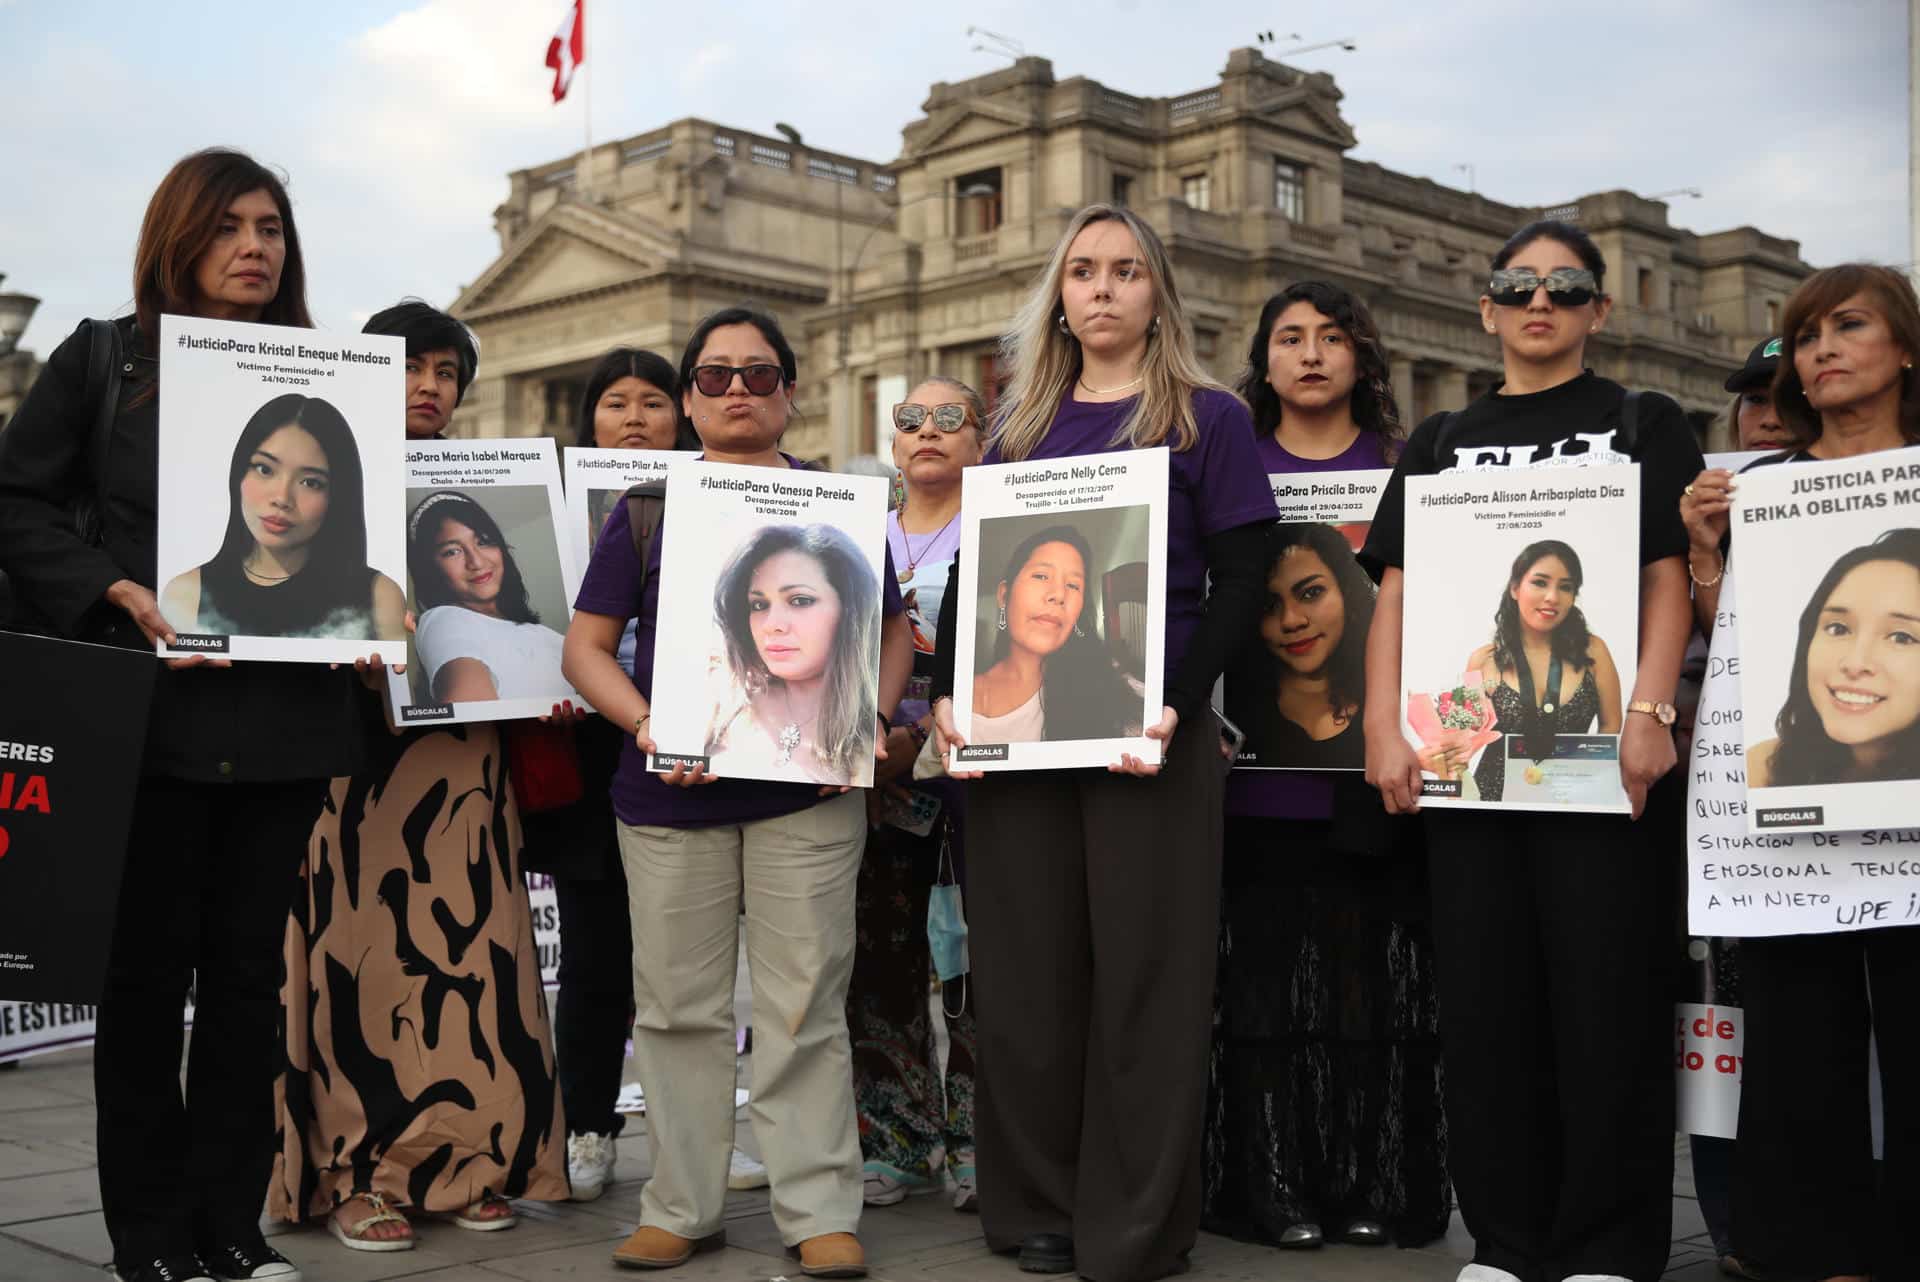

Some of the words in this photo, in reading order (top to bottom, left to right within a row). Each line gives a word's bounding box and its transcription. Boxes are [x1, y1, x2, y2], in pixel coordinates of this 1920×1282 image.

[178, 335, 255, 354] #JusticiaPara
[259, 342, 295, 357] Kristal
[298, 346, 339, 362] Eneque
[341, 350, 391, 365] Mendoza
[274, 365, 325, 377] Feminicidio
[327, 369, 335, 377] el
[261, 375, 311, 386] 24/10/2025
[442, 451, 470, 463] Maria
[472, 451, 499, 462] Isabel
[501, 451, 541, 463] Marquez
[577, 459, 631, 470] #JusticiaPara
[632, 460, 651, 470] Pilar
[411, 469, 463, 477] Desaparecida
[464, 468, 471, 476] el
[1004, 470, 1068, 486] #JusticiaPara
[1071, 466, 1096, 480] Nelly
[1098, 464, 1127, 476] Cerna
[1792, 470, 1876, 495] JUSTICIA
[1882, 463, 1920, 483] PAR
[460, 477, 495, 486] Arequipa
[700, 476, 769, 493] #JusticiaPara
[772, 482, 813, 497] Vanessa
[815, 486, 855, 501] Pereida
[1015, 488, 1067, 500] Desaparecida
[1068, 487, 1076, 495] el
[1077, 484, 1114, 494] 17/12/2017
[1311, 483, 1346, 496] Priscila
[1348, 483, 1377, 495] Bravo
[1420, 492, 1489, 507] #JusticiaPara
[1491, 489, 1527, 503] Alisson
[1530, 487, 1597, 502] Arribasplata
[1600, 484, 1625, 498] Díaz
[745, 495, 800, 507] Desaparecida
[802, 500, 809, 508] el
[1025, 499, 1051, 509] Trujillo
[1059, 498, 1069, 506] La
[1070, 494, 1104, 505] Libertad
[1310, 503, 1317, 511] el
[1743, 503, 1801, 523] ERIKA
[1806, 492, 1888, 516] OBLITAS
[1508, 510, 1557, 519] Feminicidio
[1558, 509, 1566, 517] el
[1711, 657, 1740, 679] DE
[407, 706, 449, 716] BÚSCALAS
[0, 741, 55, 763] ERES
[962, 747, 1003, 757] BÚSCALAS
[1696, 738, 1744, 758] SABE
[1762, 810, 1817, 823] BÚSCALAS
[1813, 832, 1840, 847] DE
[1851, 860, 1920, 876] TENGO
[1708, 895, 1720, 910] A
[1765, 891, 1831, 908] NIETO
[1836, 901, 1893, 924] UPE
[1693, 1007, 1735, 1040] de
